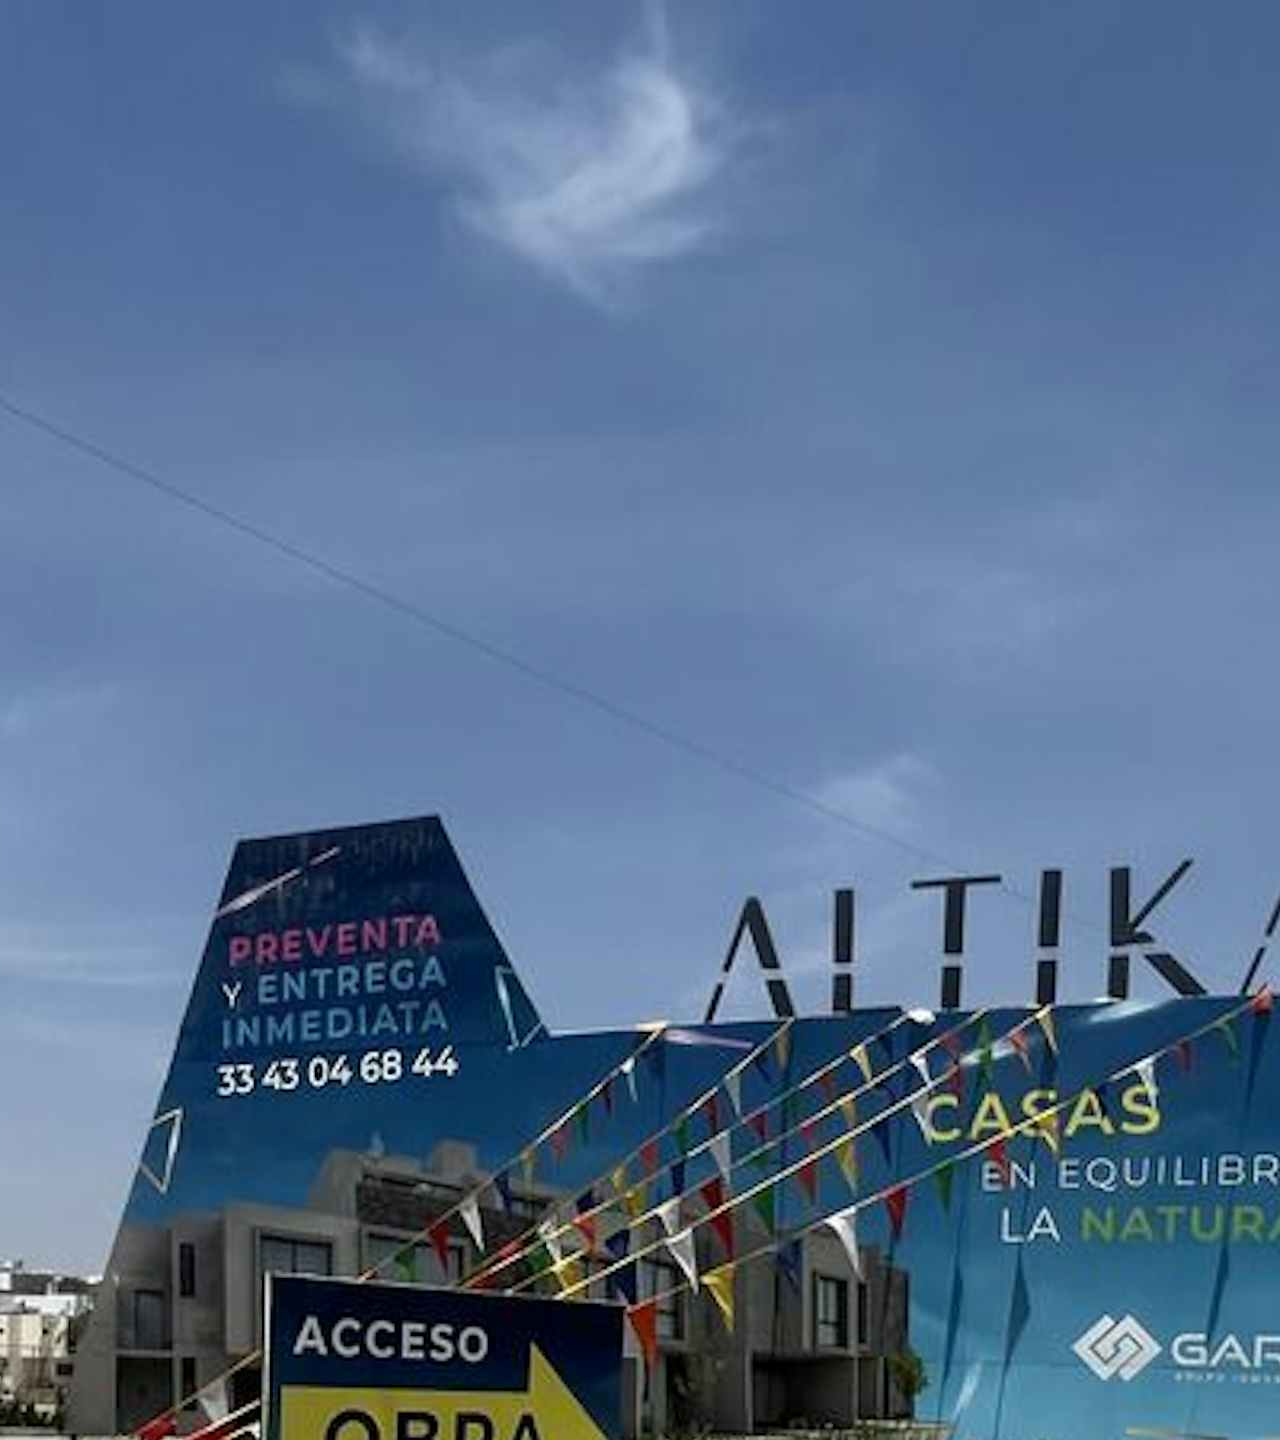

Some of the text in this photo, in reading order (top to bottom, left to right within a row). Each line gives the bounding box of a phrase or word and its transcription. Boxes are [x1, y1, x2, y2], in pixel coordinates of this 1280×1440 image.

[228, 914, 443, 967] PREVENTA
[222, 955, 447, 1009] Y ENTREGA
[222, 999, 450, 1048] INMEDIATA
[216, 1046, 459, 1096] 33 43 04 68 44
[926, 1084, 1161, 1141] CASAS
[981, 1160, 1036, 1191] EN
[1001, 1208, 1060, 1243] LA
[293, 1316, 489, 1362] ACCESO
